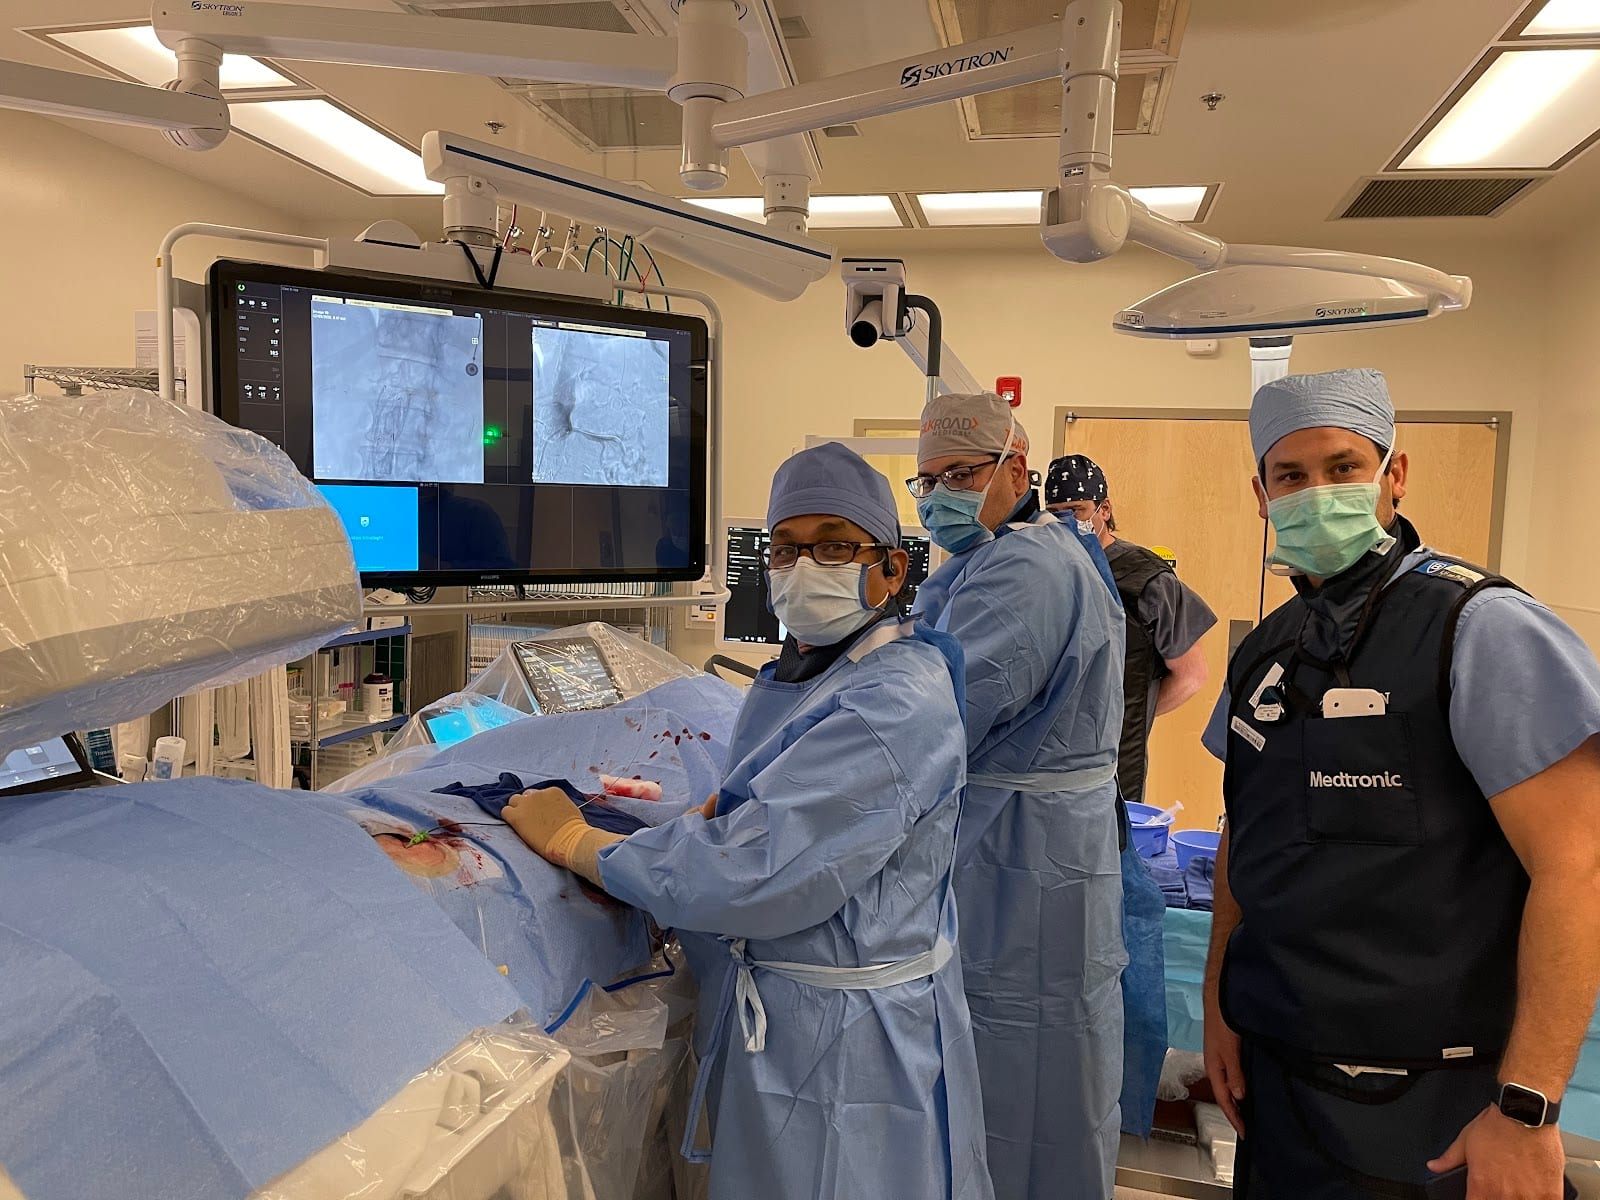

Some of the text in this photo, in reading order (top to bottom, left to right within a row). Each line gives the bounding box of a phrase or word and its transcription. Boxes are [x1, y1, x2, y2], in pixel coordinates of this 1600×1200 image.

[202, 3, 242, 11] SKYTRON
[923, 47, 1010, 81] SKYTRON
[1326, 306, 1366, 316] SKYTRON
[1310, 770, 1403, 788] Medtronic
